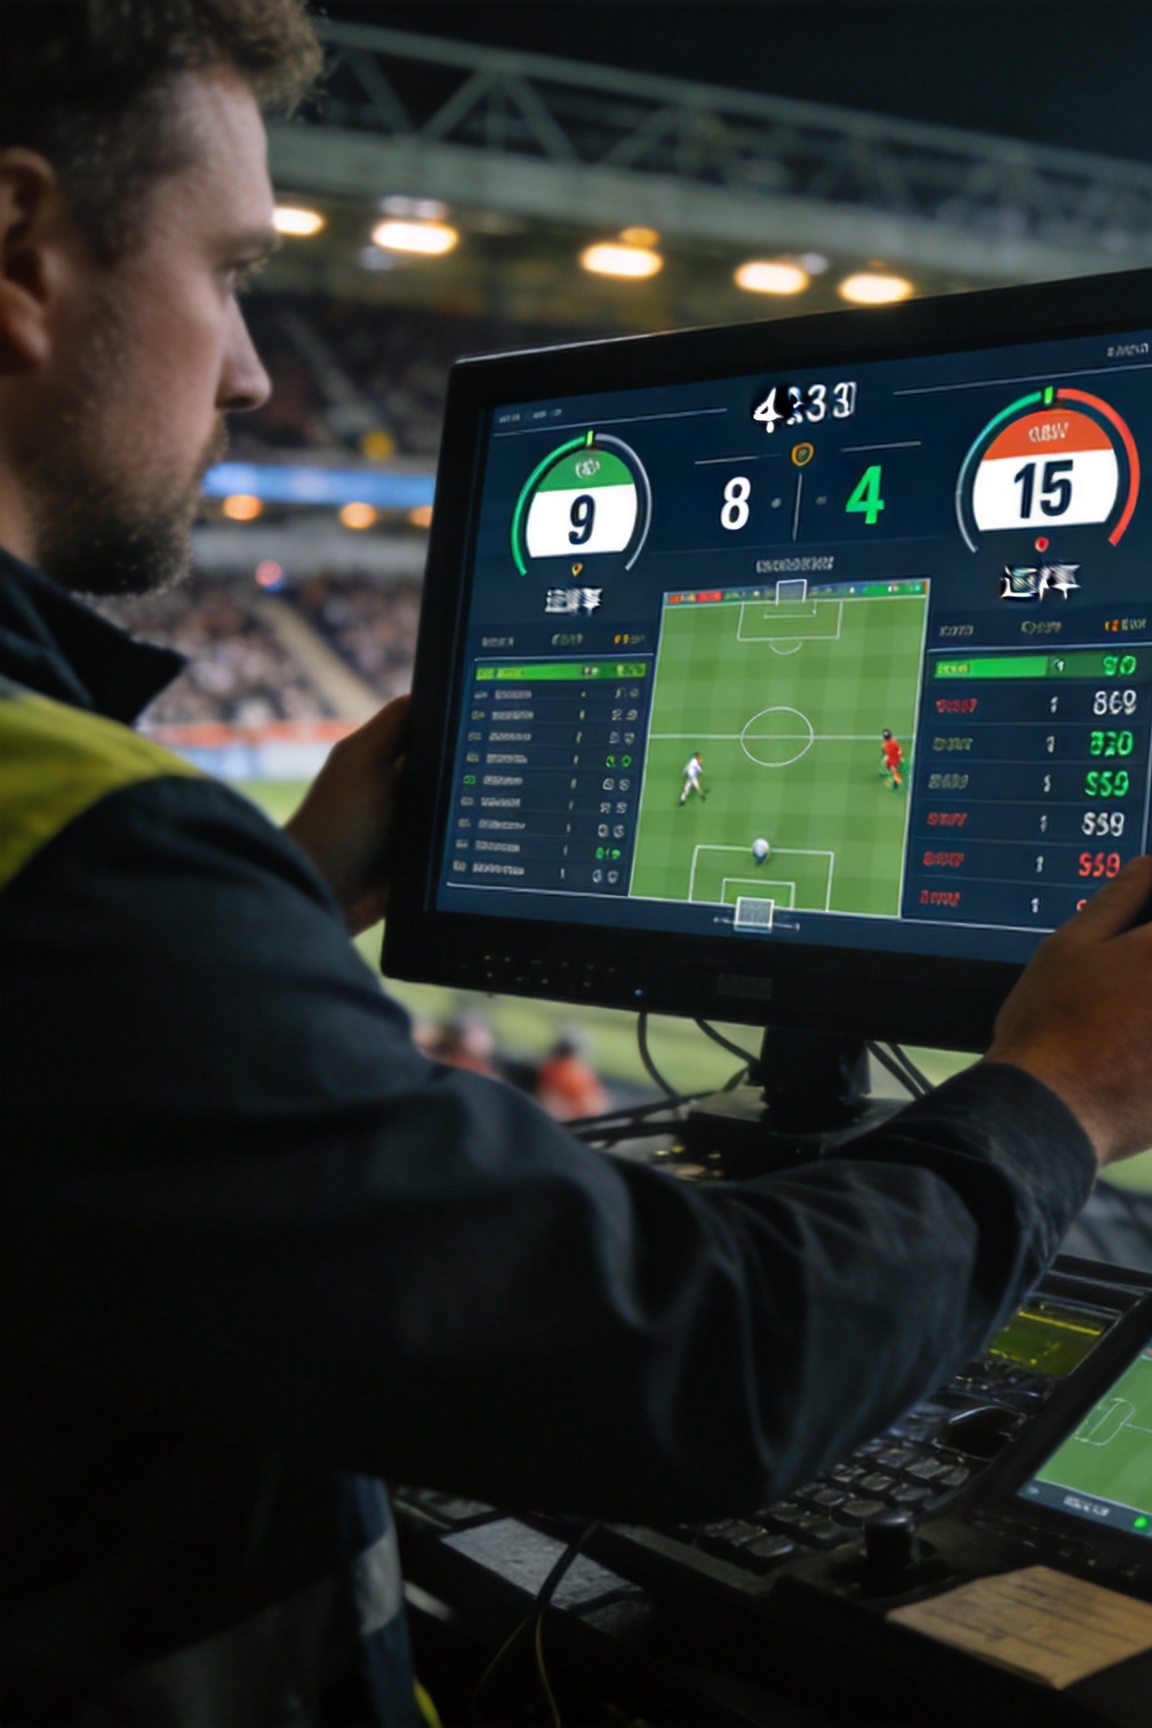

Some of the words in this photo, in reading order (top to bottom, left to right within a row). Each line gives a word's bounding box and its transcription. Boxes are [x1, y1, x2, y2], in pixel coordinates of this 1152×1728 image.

[720, 476, 751, 530] 8
[845, 464, 885, 525] 4
[1013, 458, 1075, 519] 15
[568, 494, 596, 545] 9
